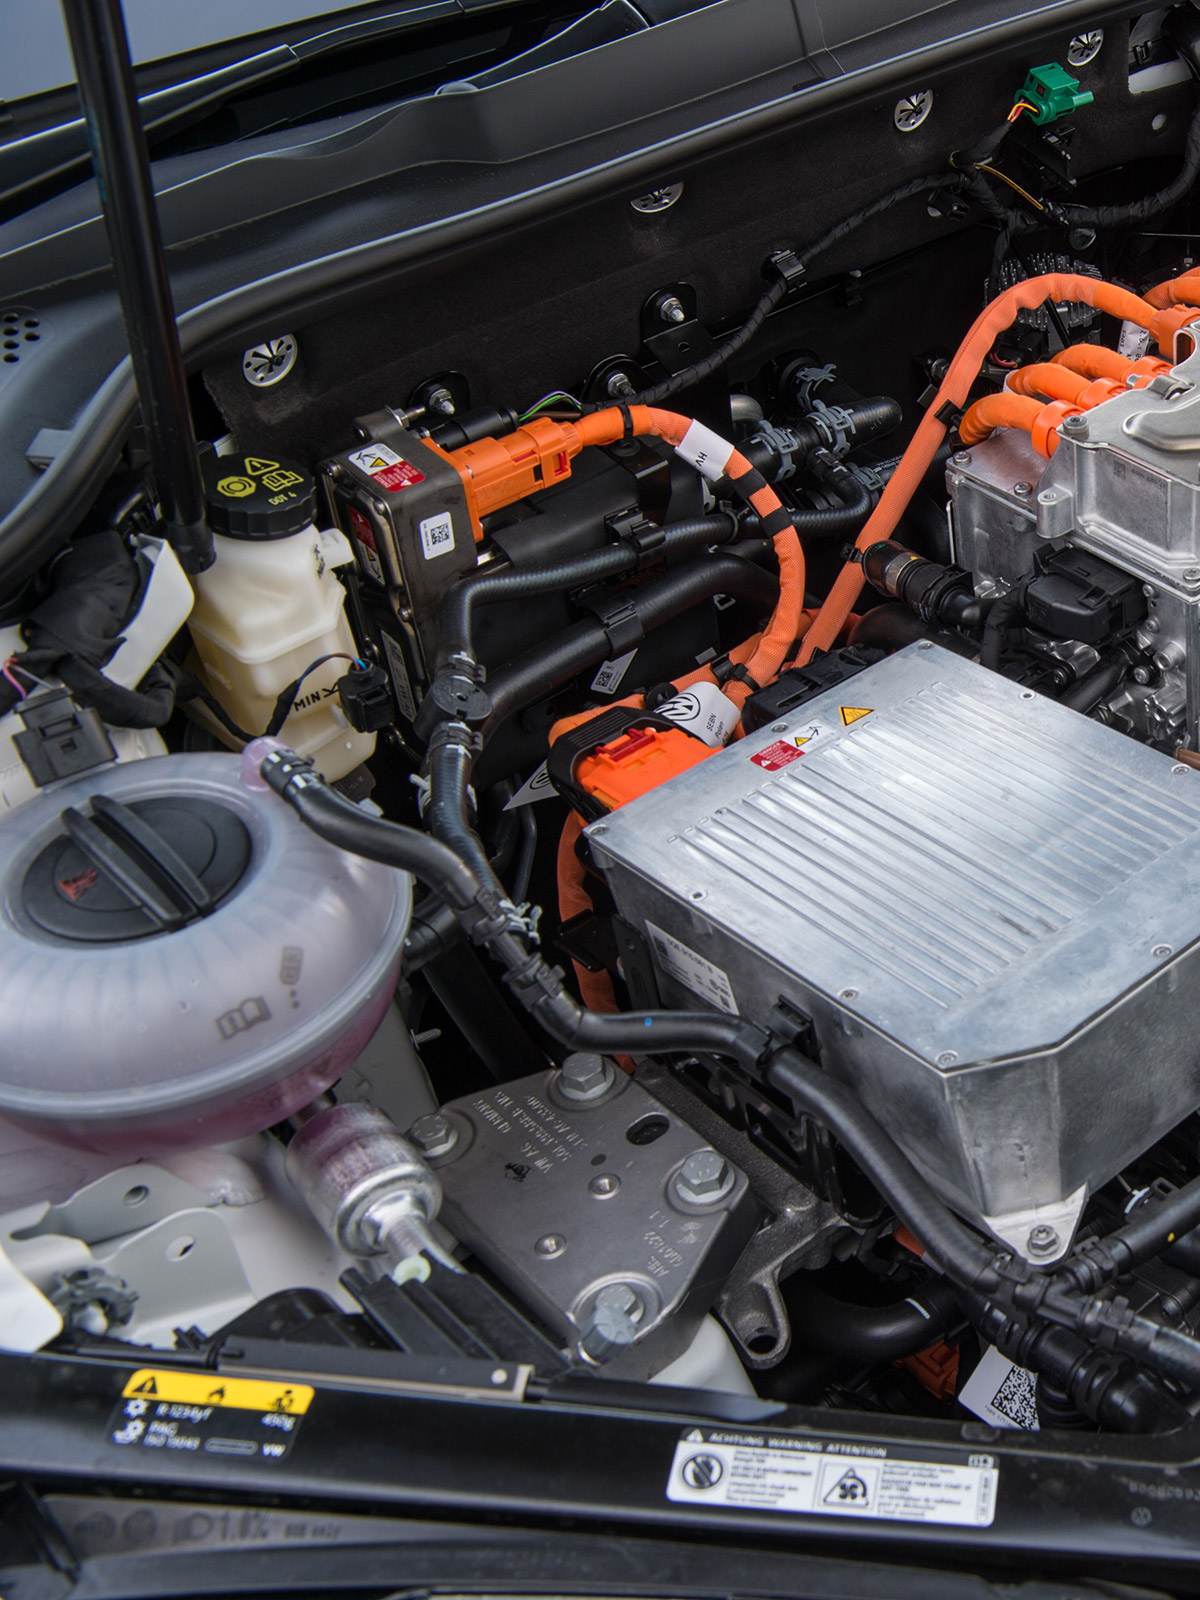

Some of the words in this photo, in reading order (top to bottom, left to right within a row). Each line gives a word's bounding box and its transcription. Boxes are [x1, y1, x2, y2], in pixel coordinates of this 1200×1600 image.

[695, 451, 708, 467] HV
[268, 493, 288, 506] DOT
[289, 491, 298, 499] 4
[293, 690, 322, 712] MIN
[705, 712, 717, 732] SEBN
[714, 721, 724, 740] Polen
[534, 1157, 554, 1174] VW
[262, 1442, 287, 1458] VW
[709, 1431, 765, 1448] ACHTUNG
[767, 1437, 824, 1452] WARNING
[826, 1442, 888, 1459] ATTENTION
